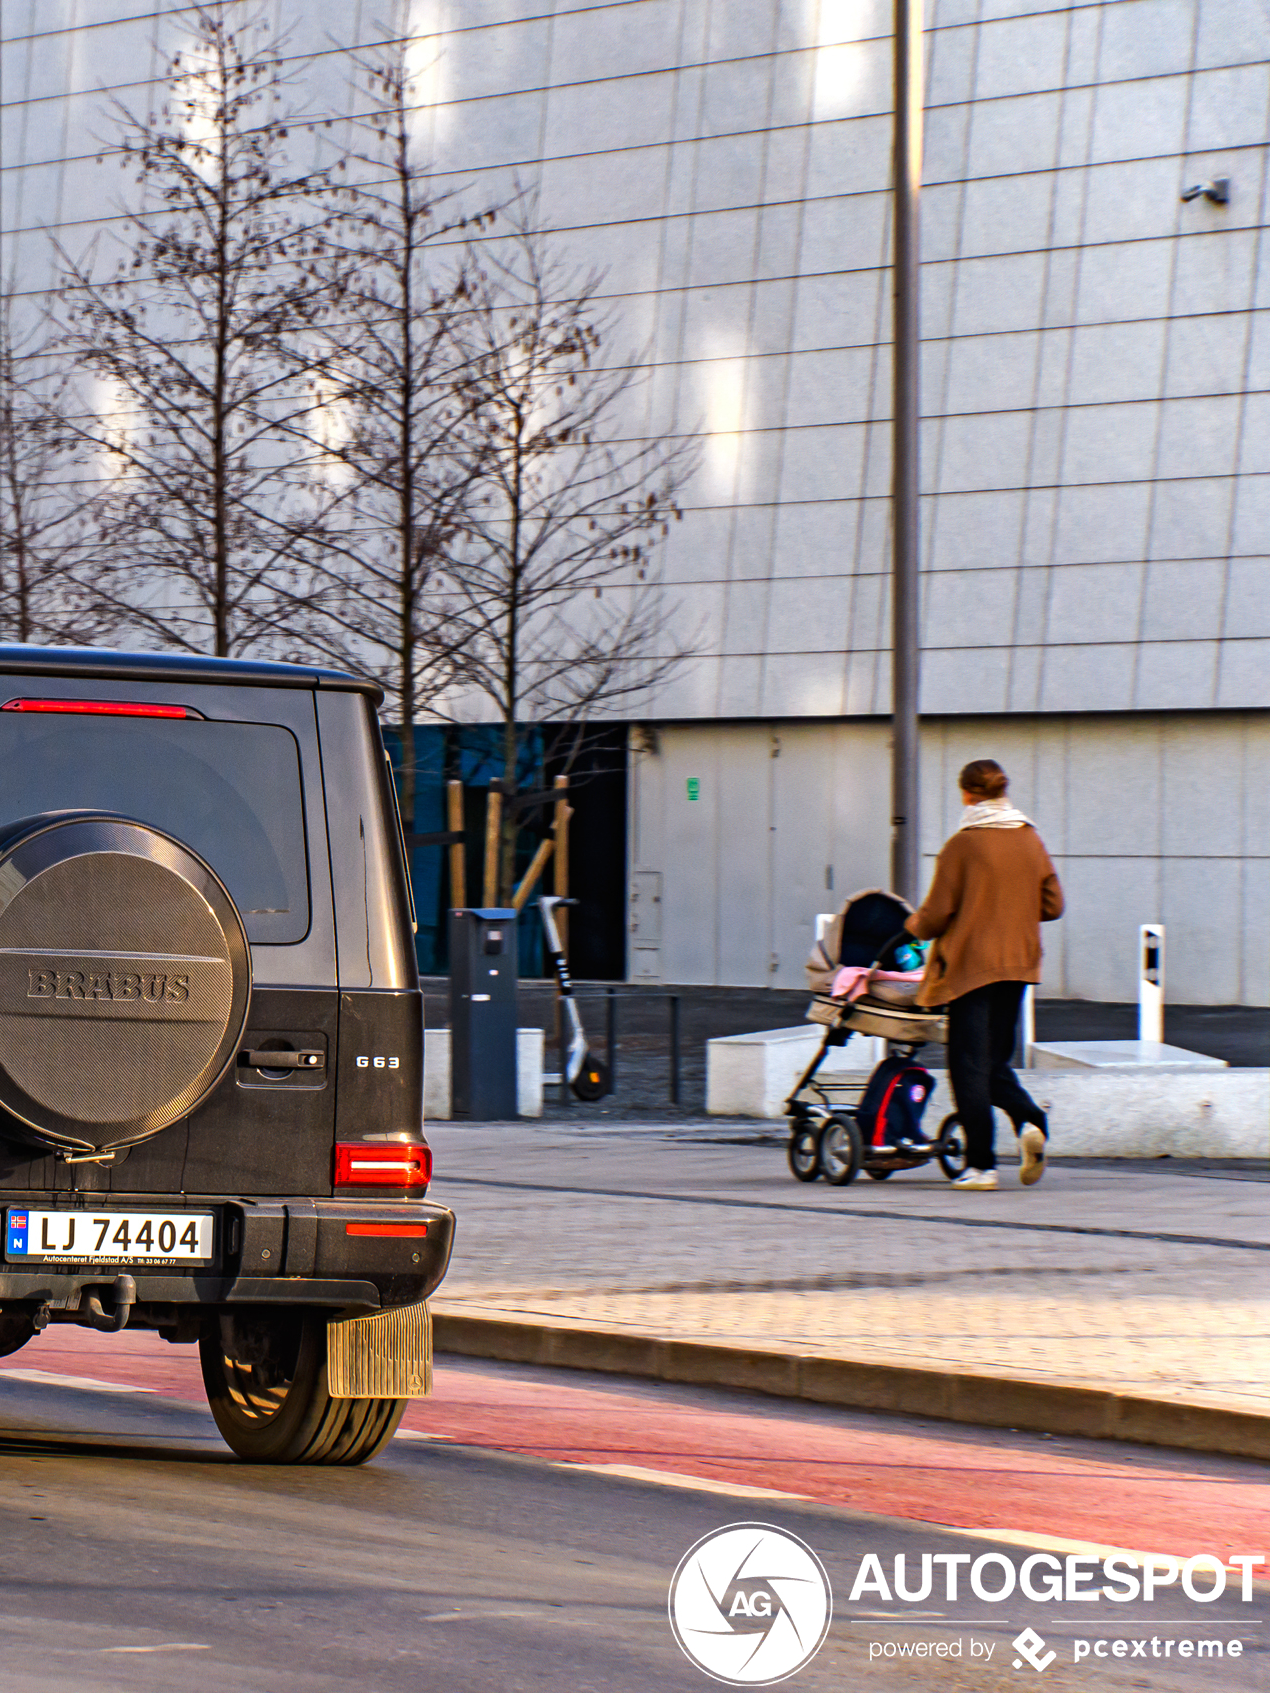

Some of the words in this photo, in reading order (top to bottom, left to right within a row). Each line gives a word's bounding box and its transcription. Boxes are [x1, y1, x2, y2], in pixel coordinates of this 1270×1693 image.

[28, 969, 189, 1003] BRABUS
[13, 1238, 23, 1249] N
[41, 1217, 76, 1251] LJ
[93, 1218, 199, 1253] 74404
[43, 1255, 87, 1263] Autocenteret
[89, 1255, 119, 1265] Fjeldstad
[120, 1256, 134, 1265] A/S
